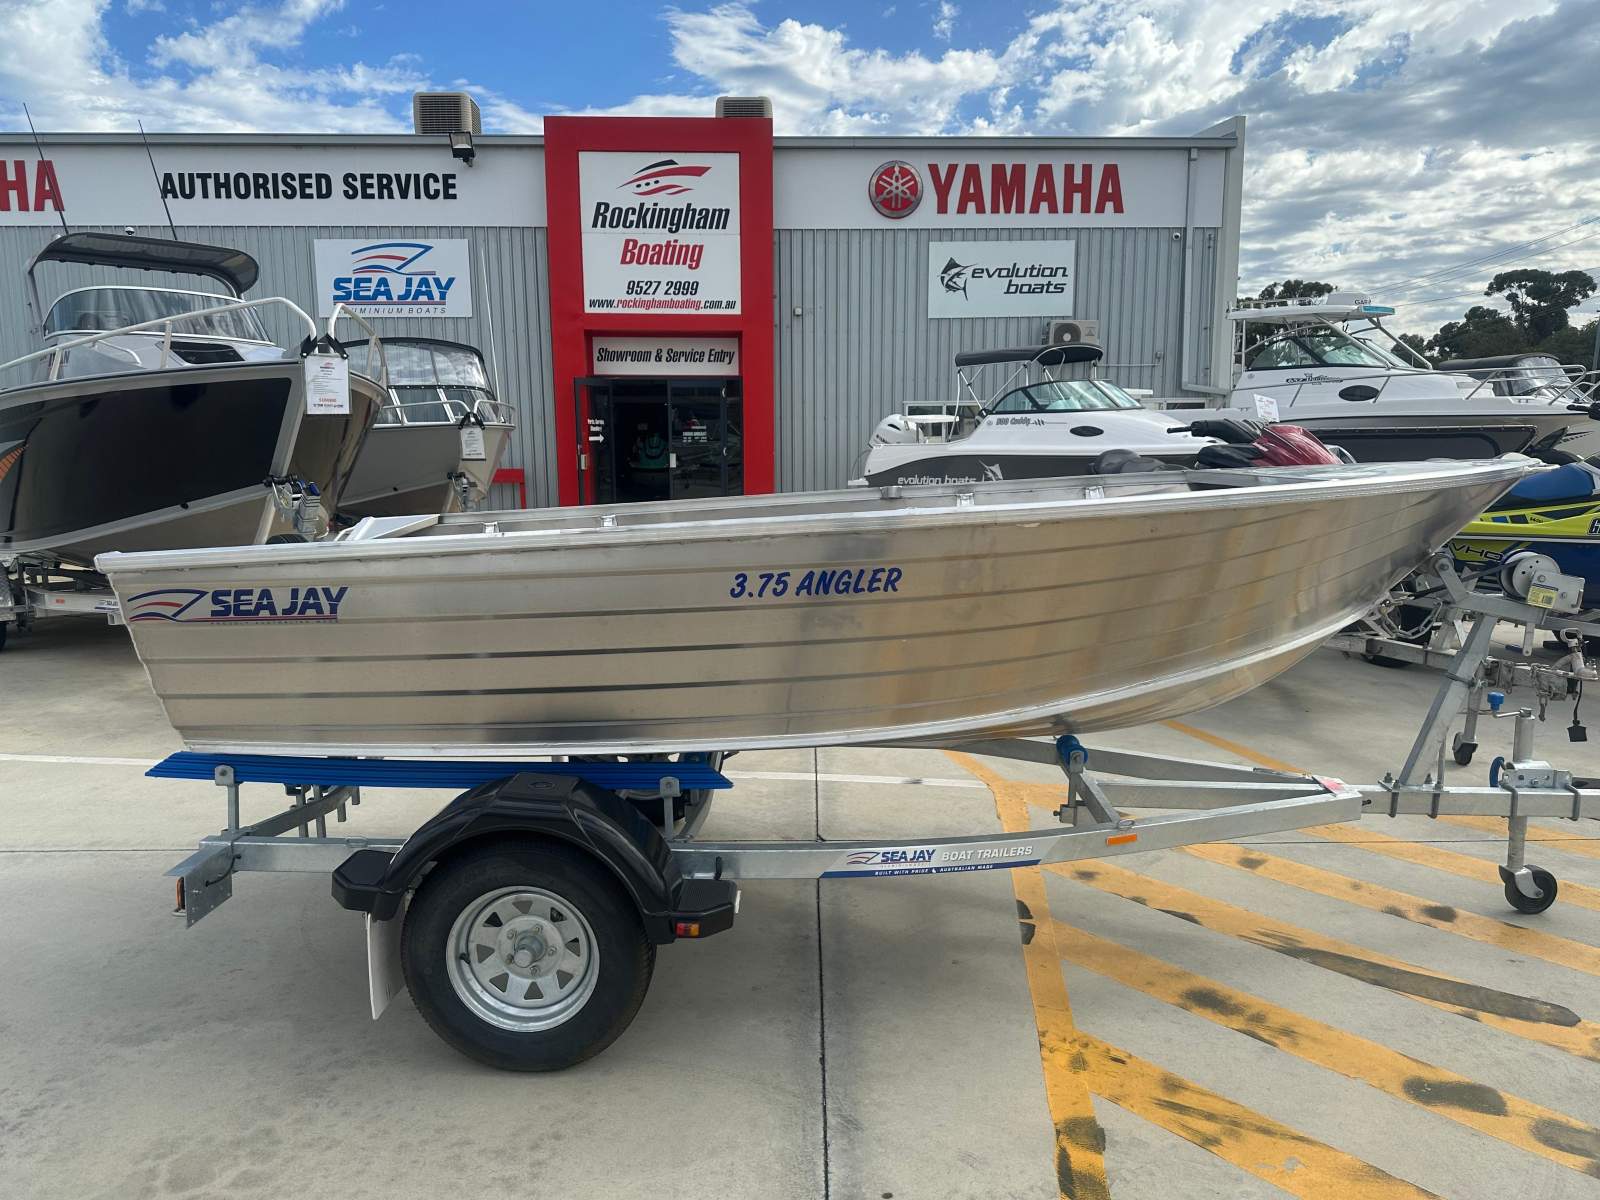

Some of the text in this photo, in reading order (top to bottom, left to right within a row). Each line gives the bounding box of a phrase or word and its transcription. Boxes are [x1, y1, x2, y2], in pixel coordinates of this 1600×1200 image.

[161, 172, 457, 200] AUTHORISED SERVICE
[928, 163, 1124, 214] YAMAHA
[592, 201, 730, 234] Rockingham
[620, 238, 704, 270] Boating
[971, 263, 1068, 279] evolution
[333, 277, 456, 301] SEA JAY
[626, 280, 699, 296] 9527 2999
[1004, 281, 1066, 295] boats
[589, 297, 736, 311] www.rockinghamboating.com.au
[597, 347, 735, 365] Showroom & Service Entry
[897, 474, 977, 486] evolution boats
[730, 567, 903, 599] 3.75 ANGLER
[210, 586, 348, 617] SEA JAY
[881, 846, 1033, 863] SEA JAY BOAT TRAILERS
